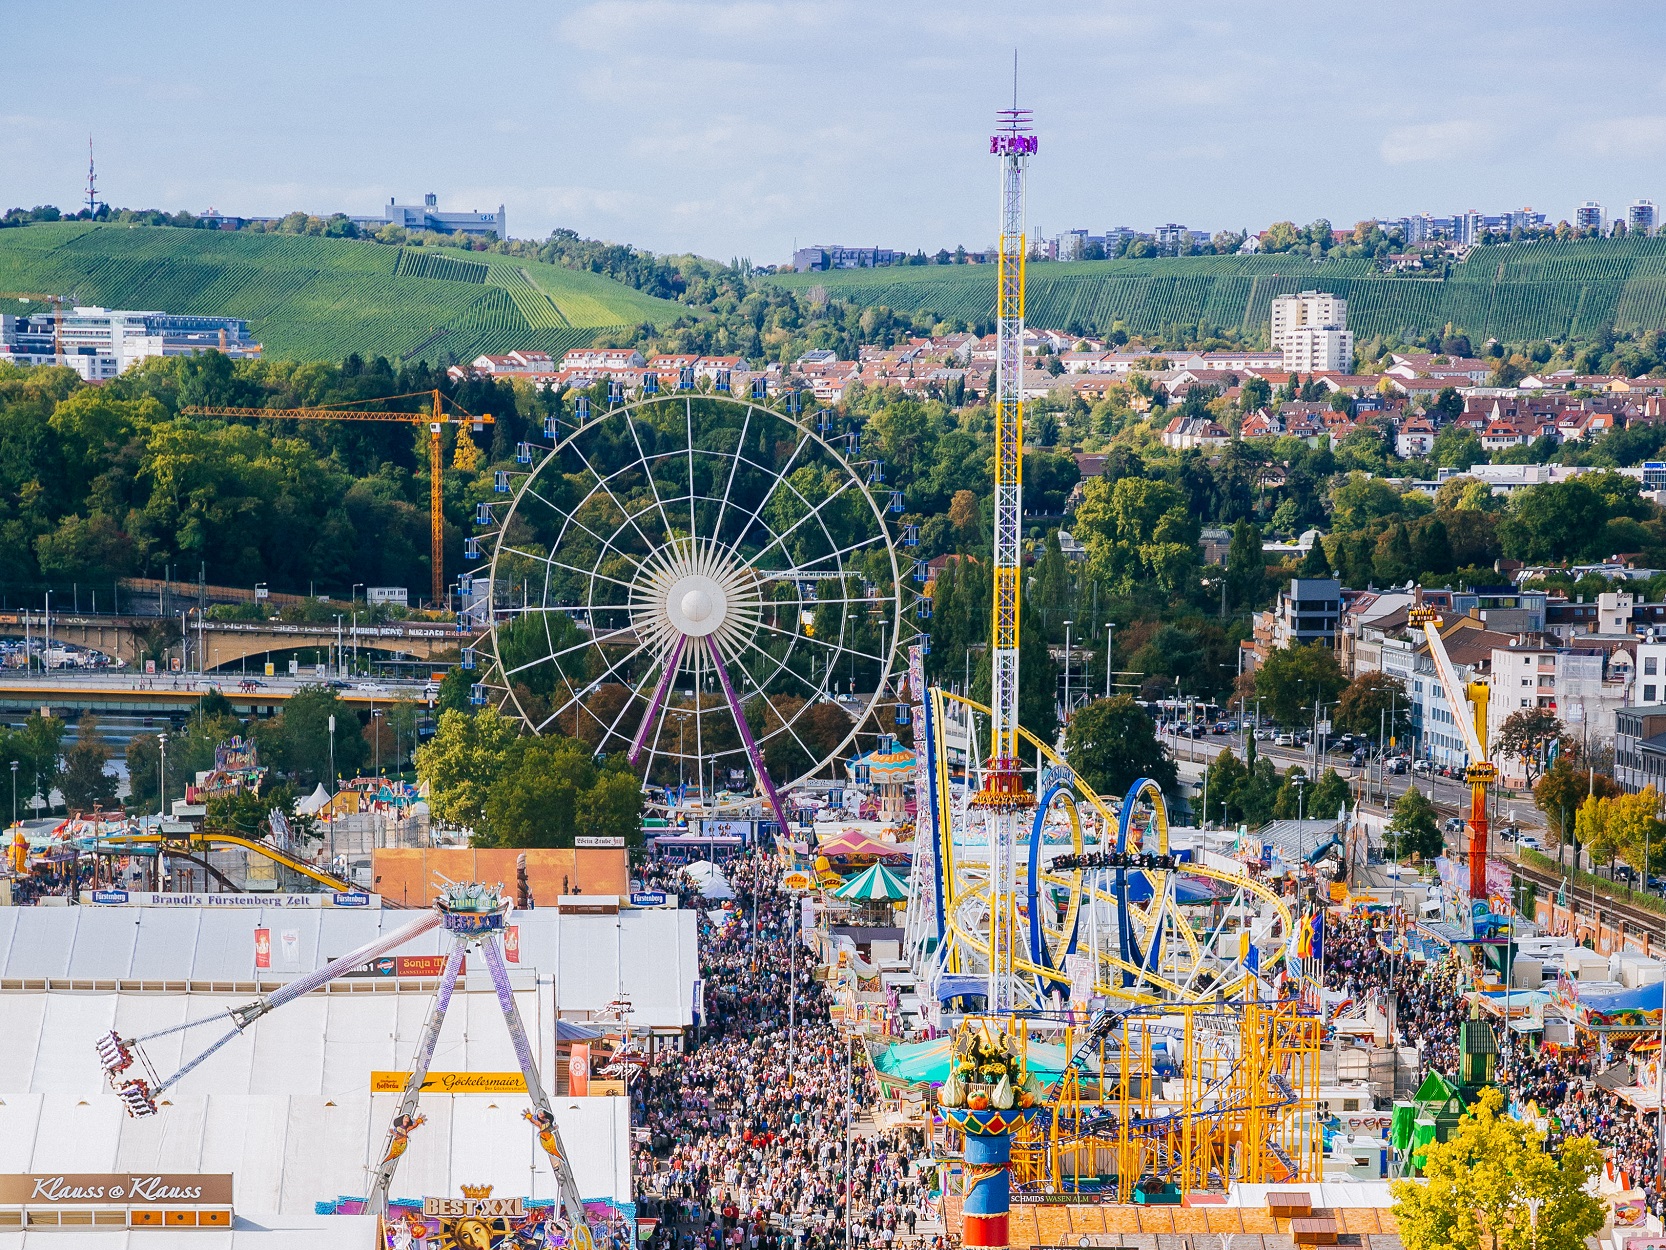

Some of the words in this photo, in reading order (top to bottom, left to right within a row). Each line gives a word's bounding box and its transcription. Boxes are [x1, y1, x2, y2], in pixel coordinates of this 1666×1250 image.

[786, 875, 807, 884] PIZZA
[95, 891, 126, 901] Fürstenberg
[152, 894, 201, 905] Brandl's
[208, 894, 282, 906] Fürstenberg
[286, 895, 310, 906] Zelt
[337, 894, 367, 904] Fürstenberg
[633, 893, 663, 903] Fürstenberg
[404, 958, 430, 969] Sonja
[442, 1073, 525, 1091] Göckelesmaier
[31, 1176, 104, 1201] Klauss
[128, 1176, 202, 1201] Klauss
[1010, 1195, 1045, 1203] SCHMIDS
[425, 1197, 477, 1217] BEST
[482, 1197, 526, 1217] XXL
